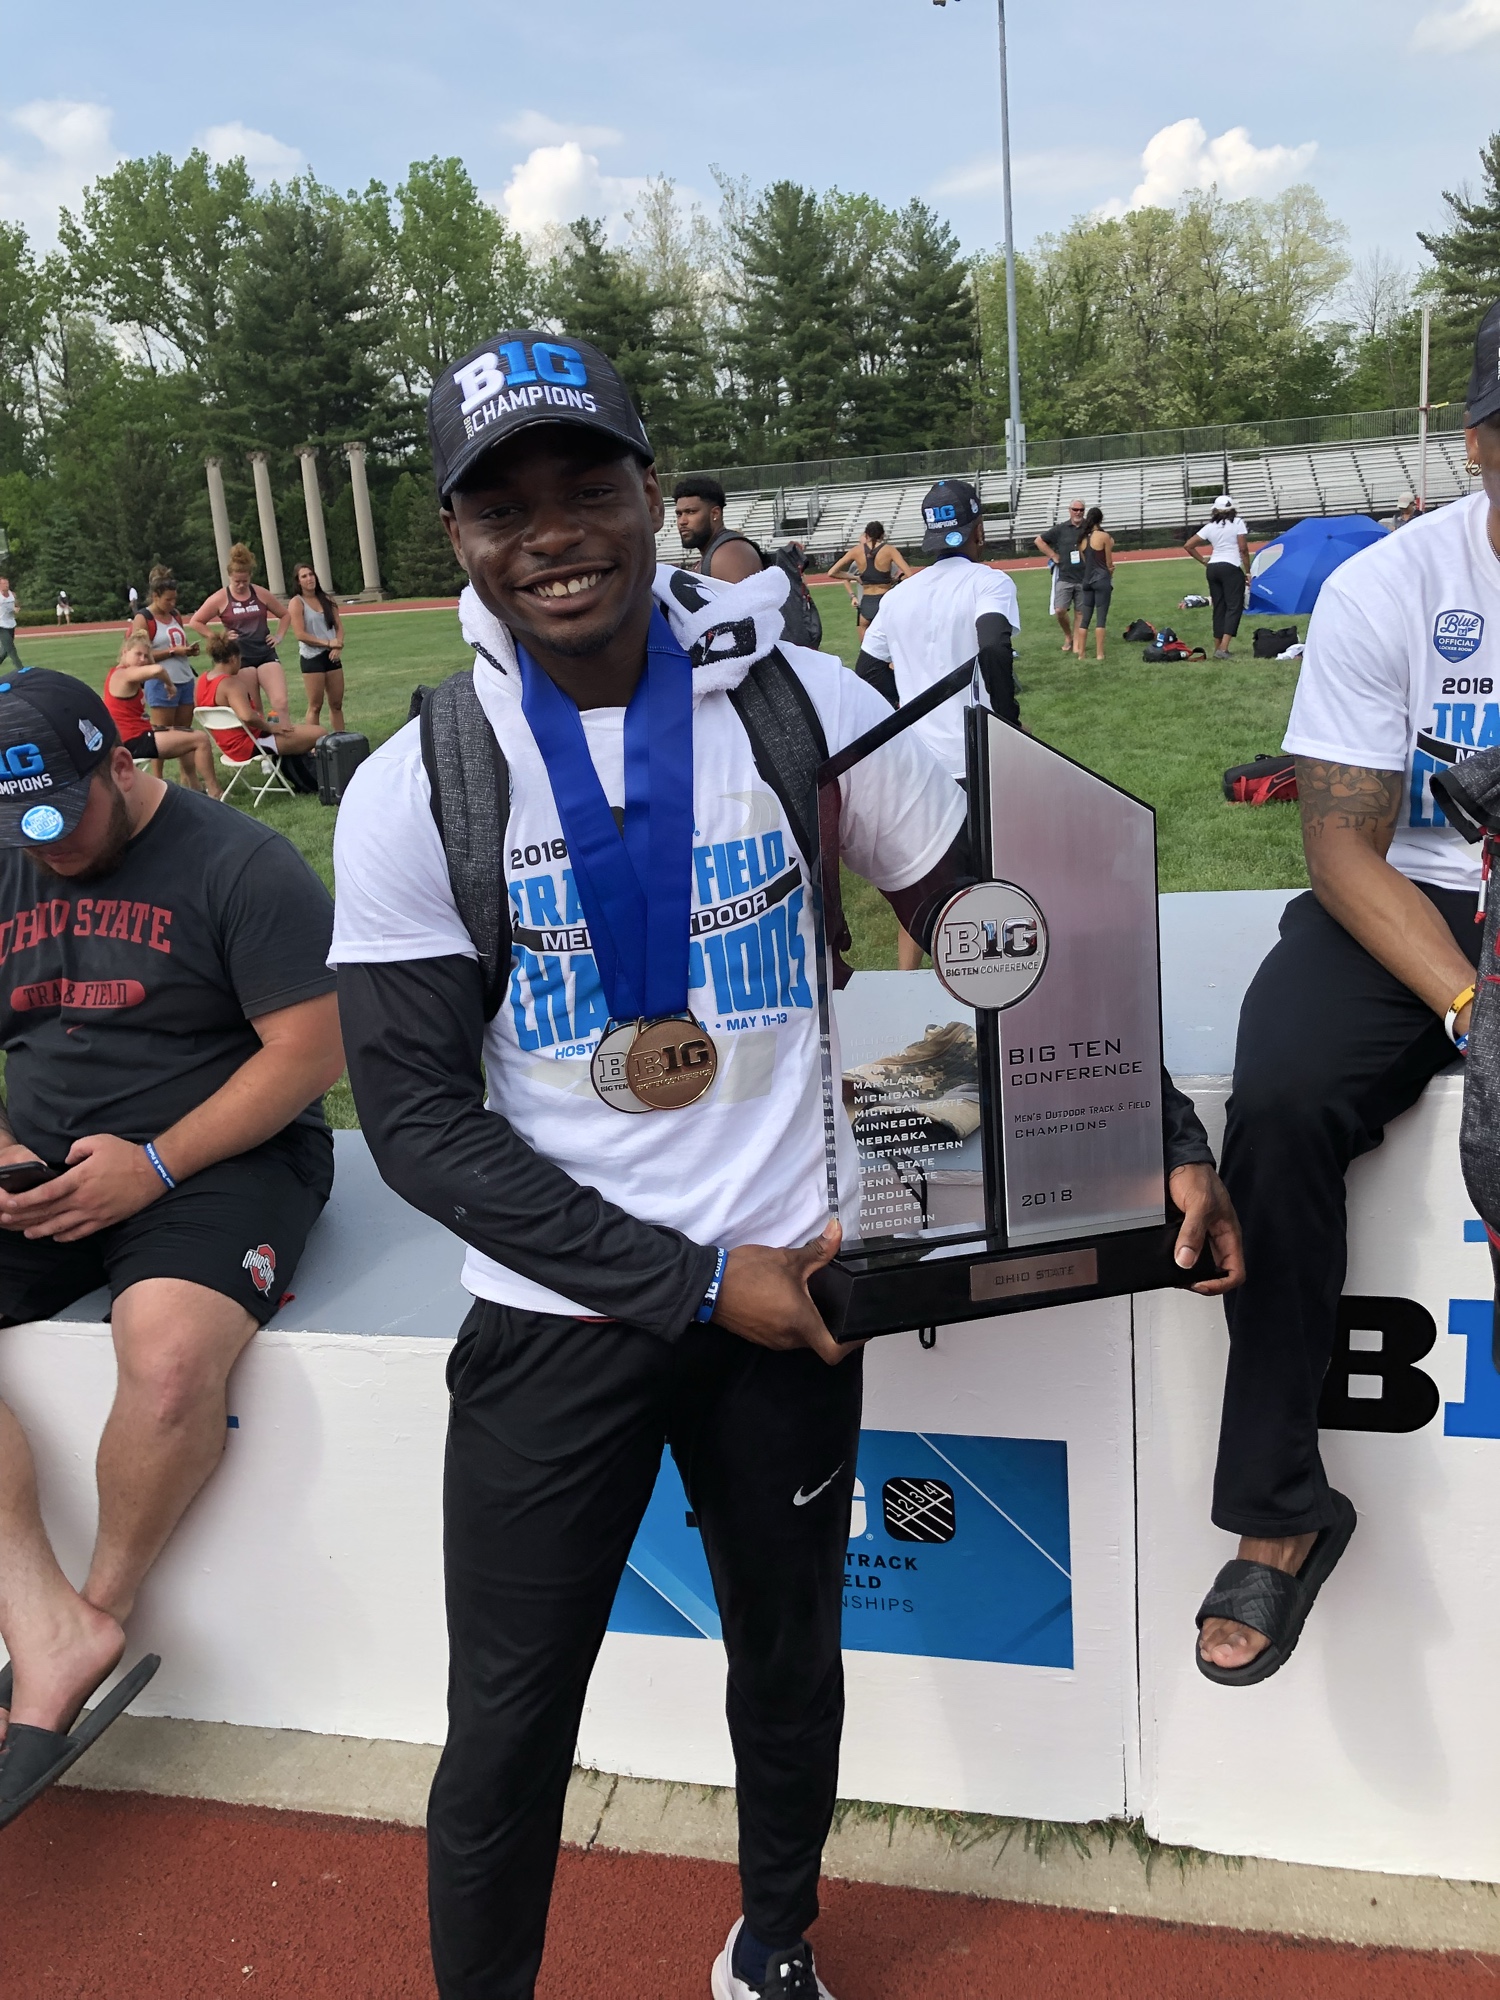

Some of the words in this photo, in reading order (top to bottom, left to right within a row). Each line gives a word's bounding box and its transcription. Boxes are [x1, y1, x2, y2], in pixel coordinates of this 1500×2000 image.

[471, 386, 597, 432] CHAMPIONS
[1438, 638, 1475, 647] OFFICIAL
[1442, 677, 1493, 695] 2018
[1433, 703, 1500, 748] TRA
[0, 773, 53, 795] MPIONS
[511, 838, 568, 869] 2018
[509, 868, 585, 926] TRA
[693, 830, 785, 905] FIELD
[74, 899, 172, 954] STATE
[945, 968, 961, 977] BIG
[961, 966, 979, 976] TEN
[980, 961, 1039, 975] CONFERENCE
[23, 980, 62, 1007] TRA
[63, 984, 75, 1004] &
[81, 983, 127, 1006] FIELD
[726, 1015, 757, 1031] MAY
[761, 1012, 787, 1026] 11-13
[1009, 1045, 1056, 1065] BIG
[1068, 1038, 1121, 1059] TEN
[853, 1076, 924, 1090] MARYLAND
[1011, 1061, 1143, 1087] CONFERENCE
[853, 1090, 920, 1104] MICHIGAN
[854, 1104, 919, 1118] MICHIGAN
[926, 1099, 964, 1110] STATE
[1118, 1102, 1124, 1111] &
[855, 1116, 932, 1132] MINNESOTA
[1015, 1119, 1107, 1139] CHAMPIONS
[856, 1131, 927, 1147] NEBRASKA
[857, 1140, 963, 1160] NORTHWESTERN
[857, 1163, 891, 1175] OHIO
[897, 1157, 935, 1170] STATE
[858, 1177, 894, 1189] PENN
[900, 1171, 938, 1183] STATE
[859, 1188, 913, 1202] PURDUE
[1021, 1189, 1073, 1207] 2018
[859, 1201, 921, 1217] RUTGERS
[859, 1213, 935, 1231] WISCONSIN
[995, 1272, 1030, 1286] OHIO
[1036, 1265, 1075, 1280] STATE
[845, 1553, 918, 1571] TRACK
[844, 1574, 881, 1589] ELD
[842, 1595, 914, 1613] NSHIPS
